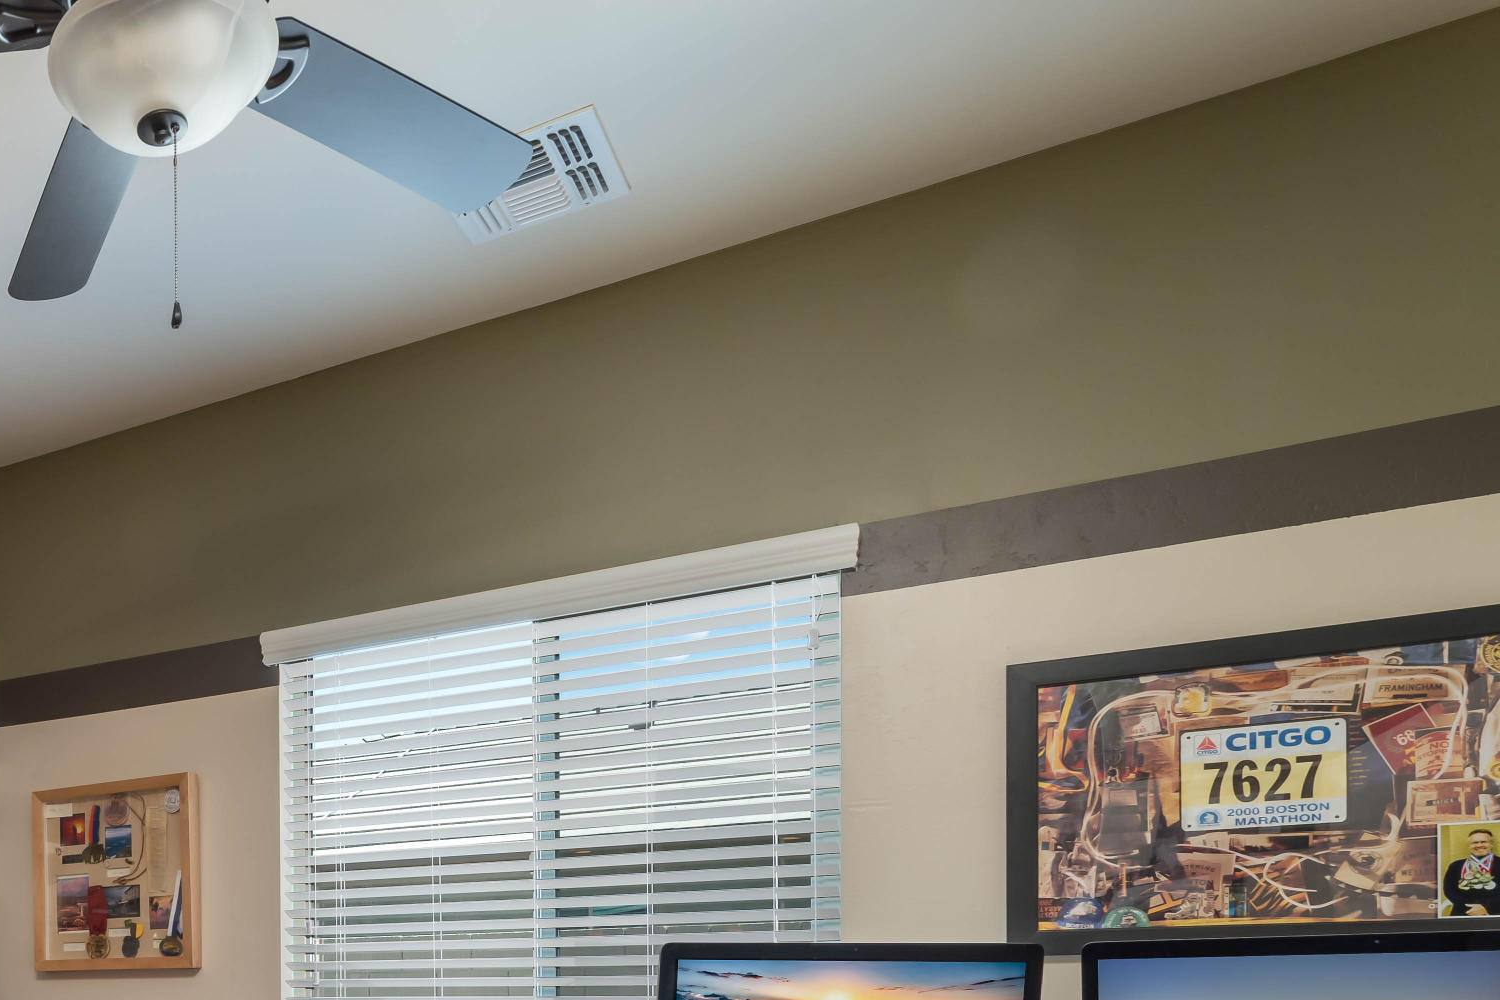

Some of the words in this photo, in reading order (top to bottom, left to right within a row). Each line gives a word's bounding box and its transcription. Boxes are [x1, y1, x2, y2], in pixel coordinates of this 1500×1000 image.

[1378, 683, 1444, 693] FRAMINGHAM
[1225, 726, 1331, 752] CITGO
[1203, 754, 1323, 805] 7627
[1227, 808, 1260, 817] 2000
[1265, 802, 1330, 815] BOSTON
[1235, 813, 1322, 826] MARATHON
